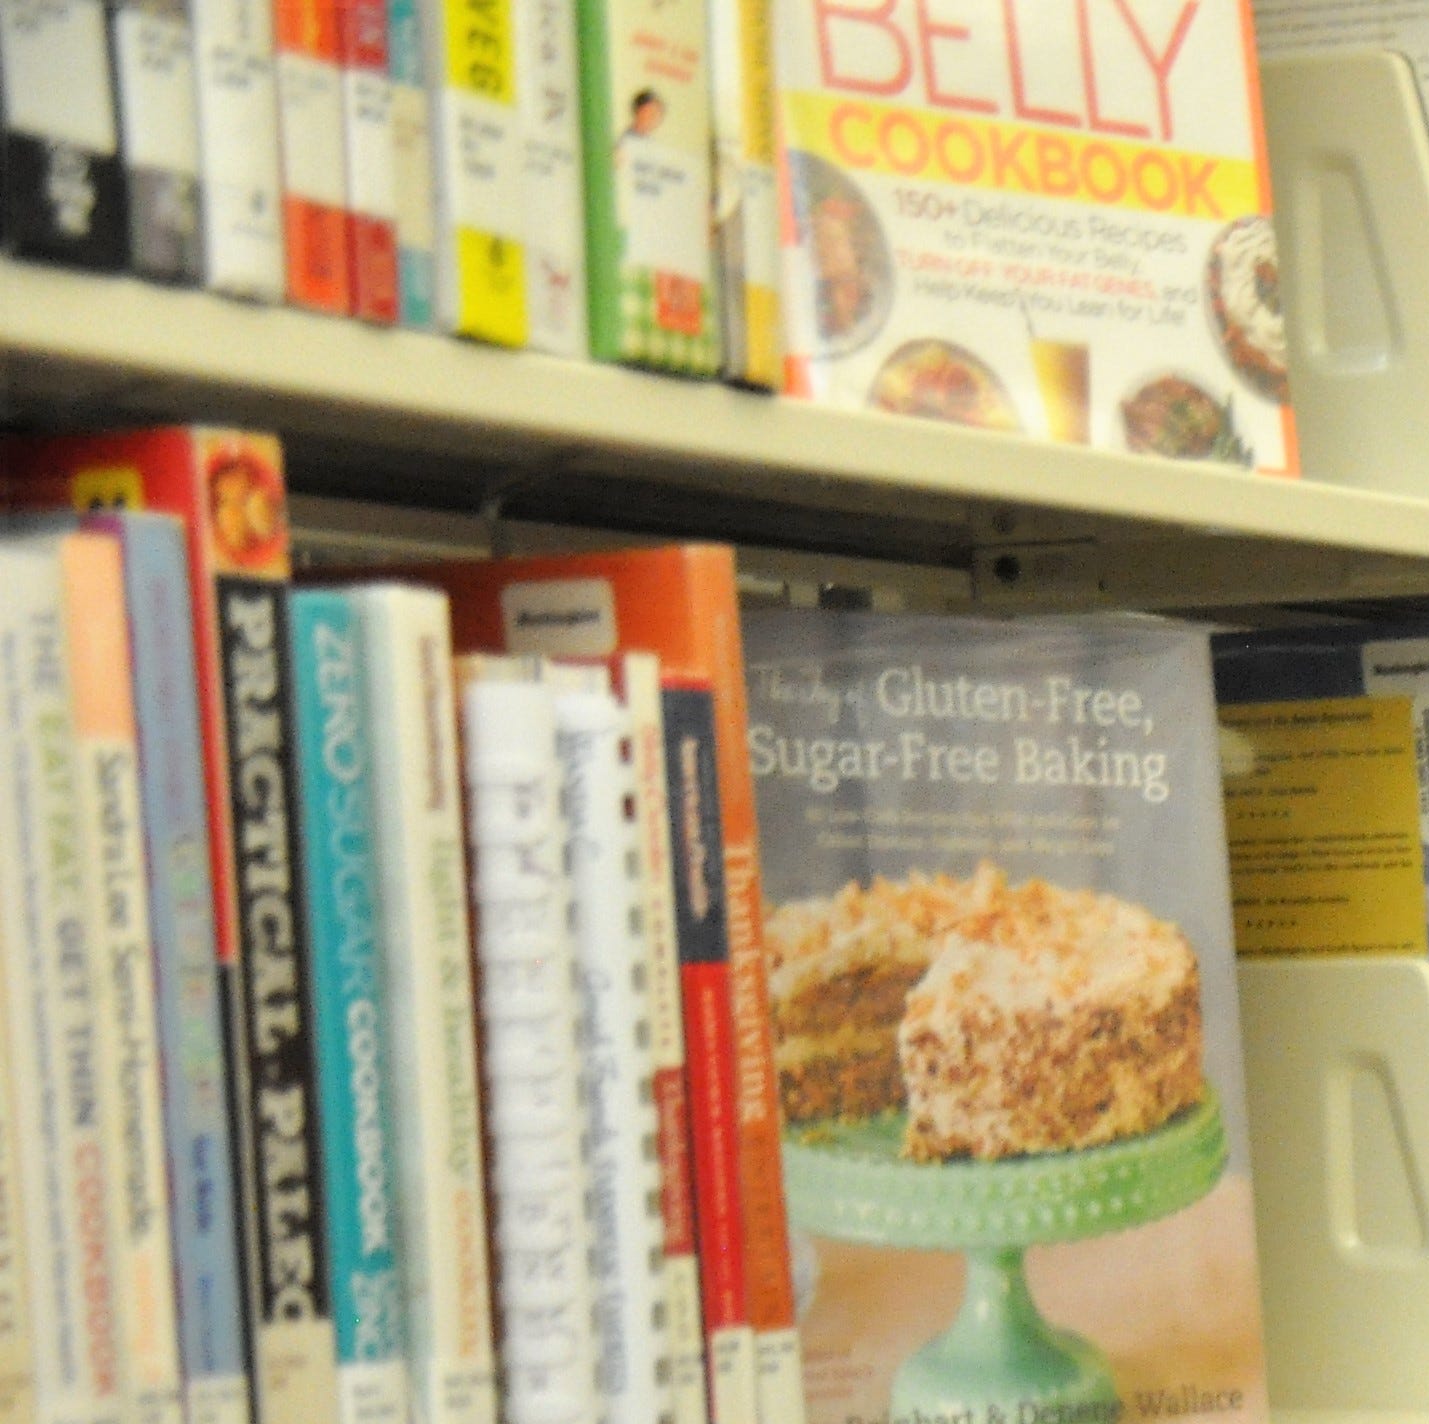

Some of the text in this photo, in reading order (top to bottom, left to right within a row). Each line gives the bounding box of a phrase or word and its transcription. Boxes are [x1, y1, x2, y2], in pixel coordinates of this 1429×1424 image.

[827, 103, 1227, 221] COOKBOOK
[875, 664, 1156, 738] Gluten-Free,
[746, 723, 1171, 803] Sugar-Free Baking
[228, 597, 300, 1050] PRACTICAL
[64, 1022, 101, 1130] THIN
[348, 1001, 391, 1254] COOKBOOK
